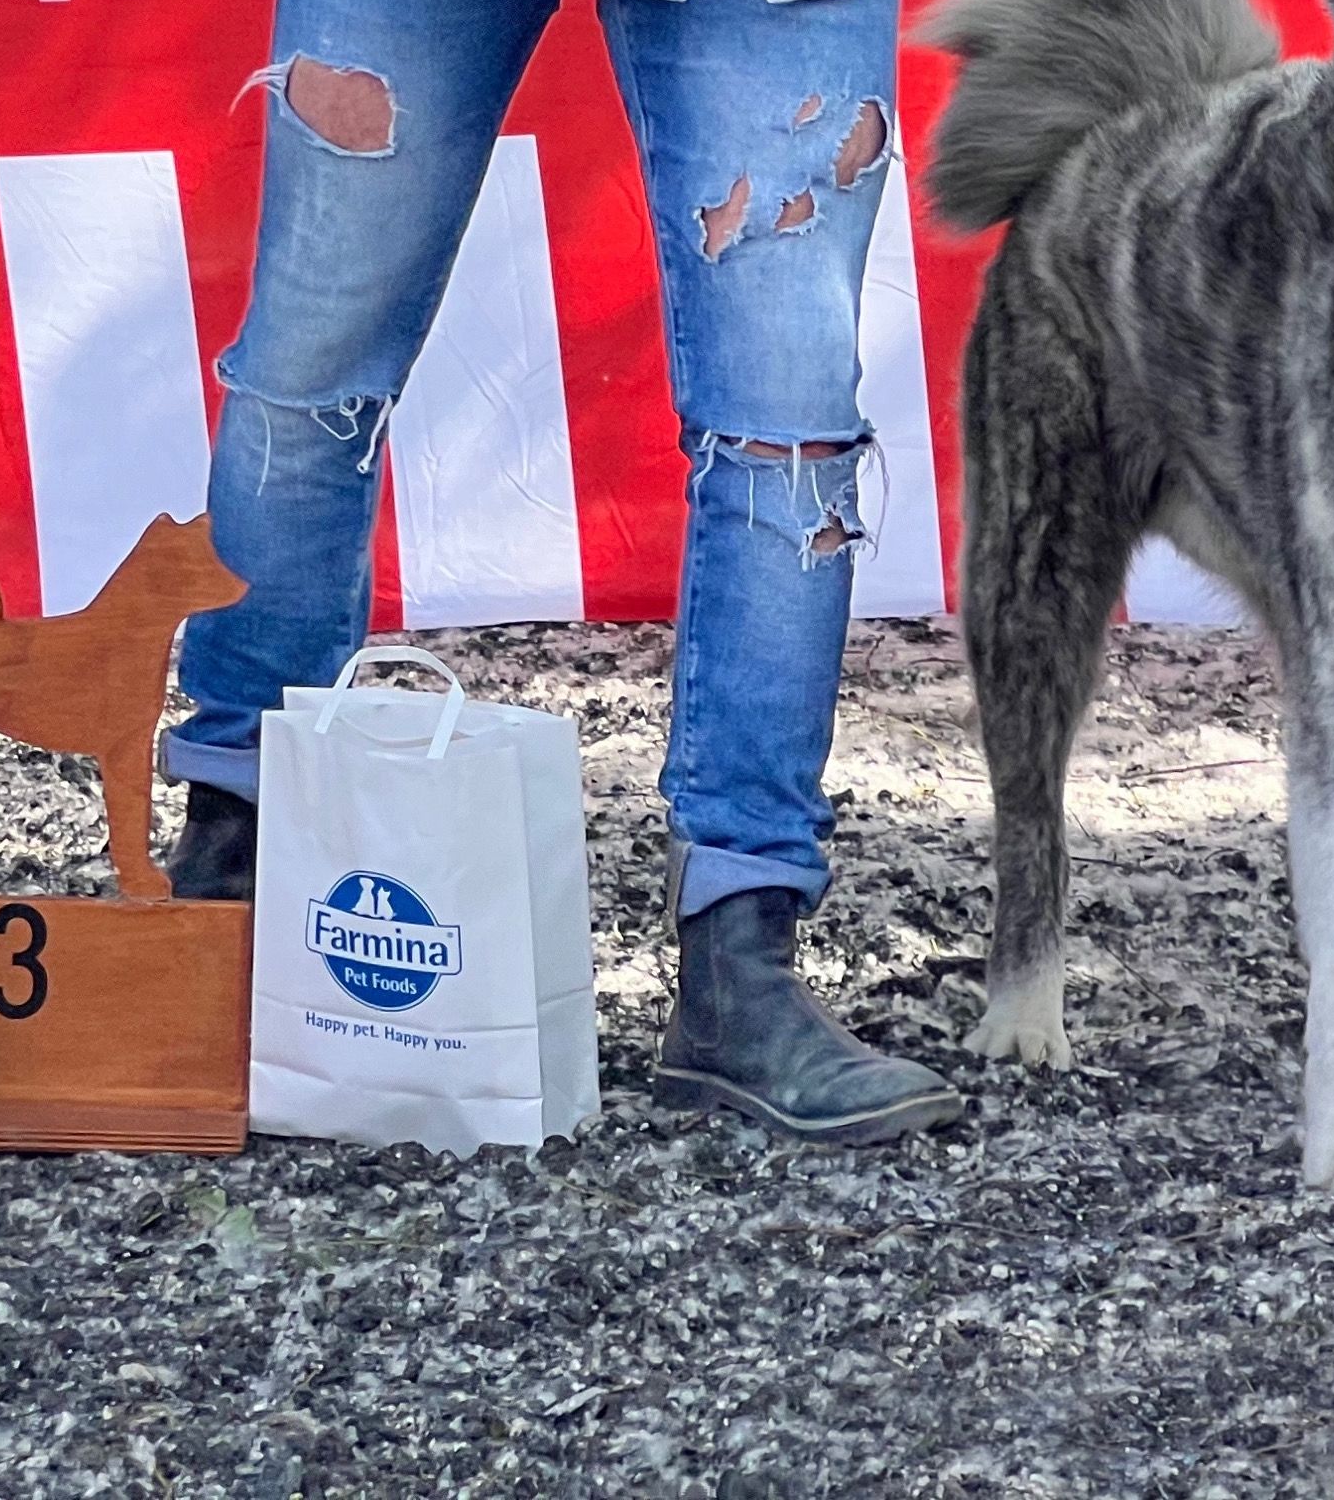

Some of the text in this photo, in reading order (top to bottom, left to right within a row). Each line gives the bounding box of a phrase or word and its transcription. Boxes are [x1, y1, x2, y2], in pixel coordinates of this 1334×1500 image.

[314, 909, 450, 968] Farmina
[344, 966, 417, 995] Pet Foods
[305, 1010, 467, 1052] Happy pet. Happy you.
